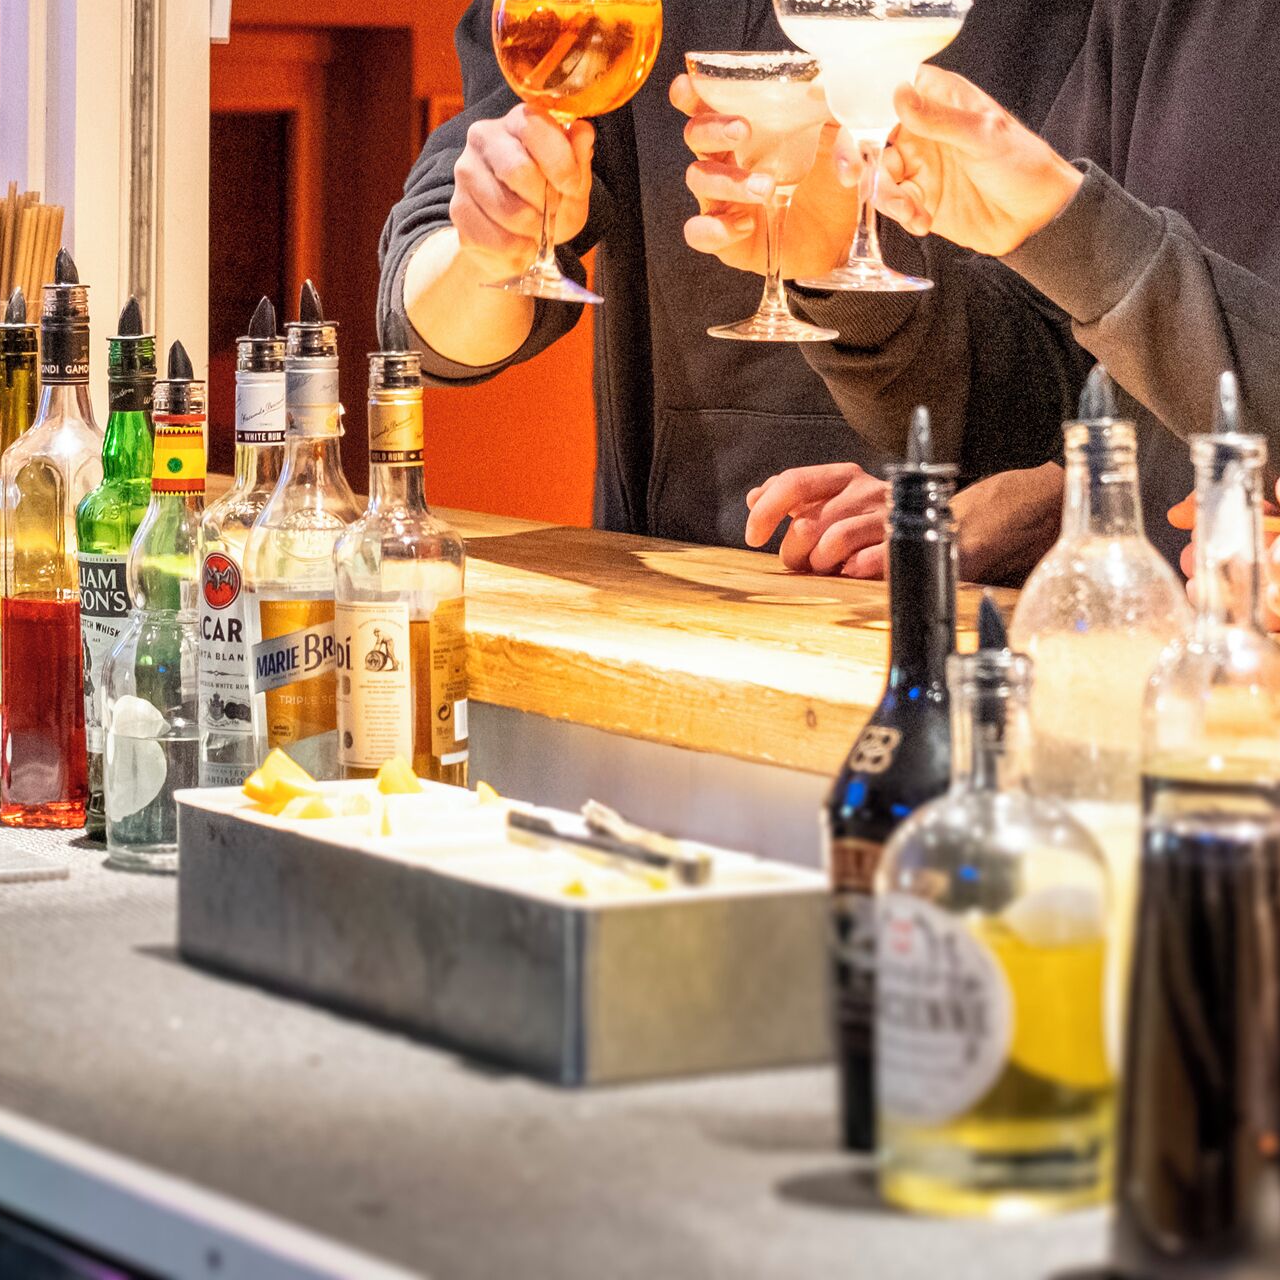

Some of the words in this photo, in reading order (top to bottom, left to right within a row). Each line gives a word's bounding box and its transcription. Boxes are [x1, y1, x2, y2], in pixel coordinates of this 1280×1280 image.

[244, 431, 267, 441] WHITE
[267, 431, 282, 441] RUM
[388, 452, 404, 462] RUM
[95, 622, 121, 638] WHISK
[200, 615, 243, 643] CAR
[256, 645, 300, 680] MARIE
[278, 694, 318, 706] TRIPLE
